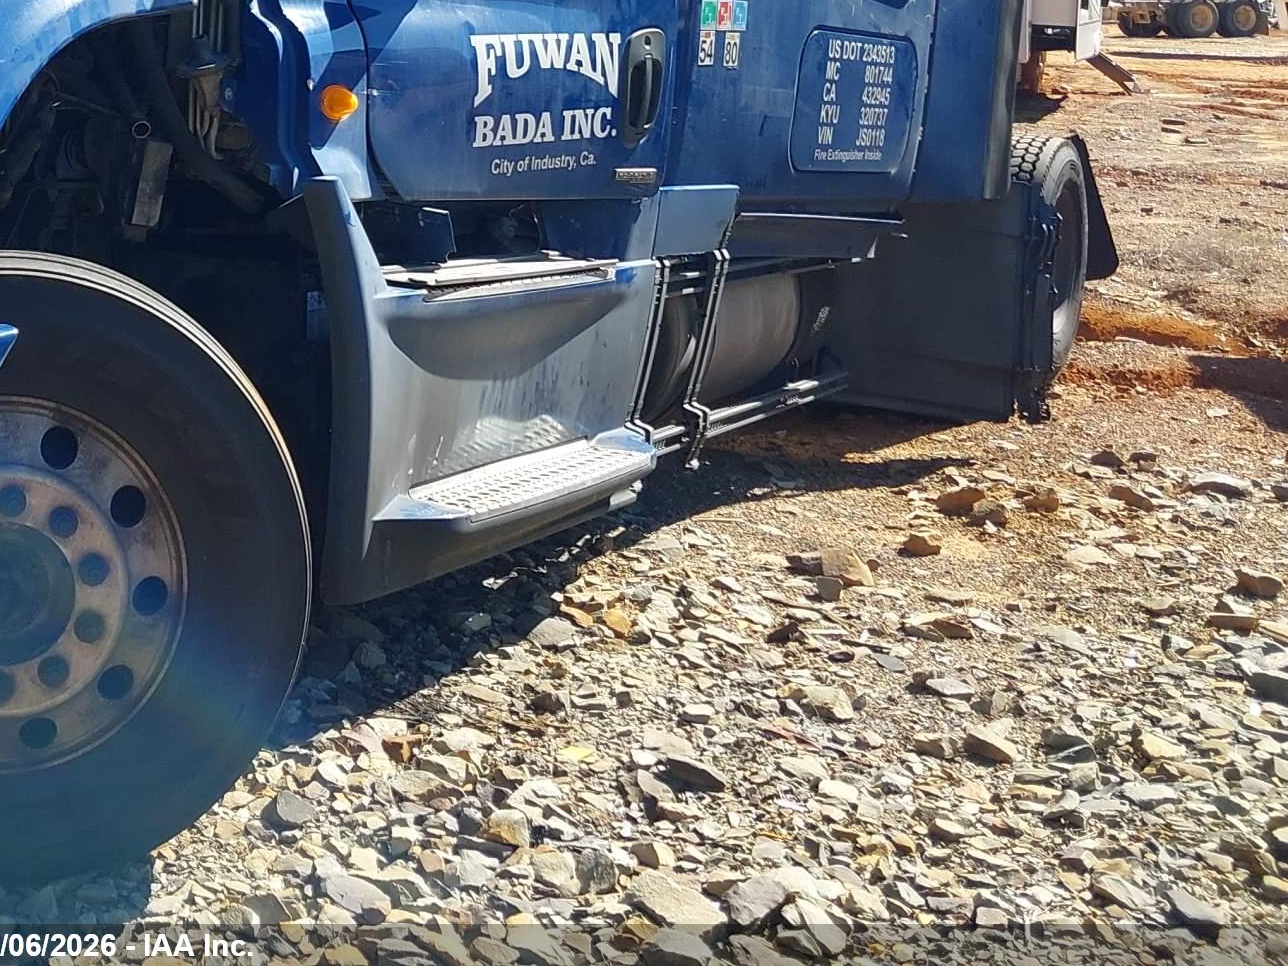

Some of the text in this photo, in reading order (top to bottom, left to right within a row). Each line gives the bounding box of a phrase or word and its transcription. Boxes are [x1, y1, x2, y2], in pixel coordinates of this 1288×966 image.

[698, 39, 714, 64] 54
[724, 41, 738, 65] 80
[828, 38, 896, 64] US DOT 2343513
[470, 33, 621, 108] FUWAN
[825, 60, 894, 85] MC 801744
[822, 82, 891, 106] CA 432945
[472, 106, 617, 148] BADA INC.
[819, 104, 889, 126] KYU 320737
[817, 126, 886, 147] VIN JS0118
[491, 150, 597, 177] City of Industry, Ca.
[814, 148, 882, 163] Fire Extinguisher Inside
